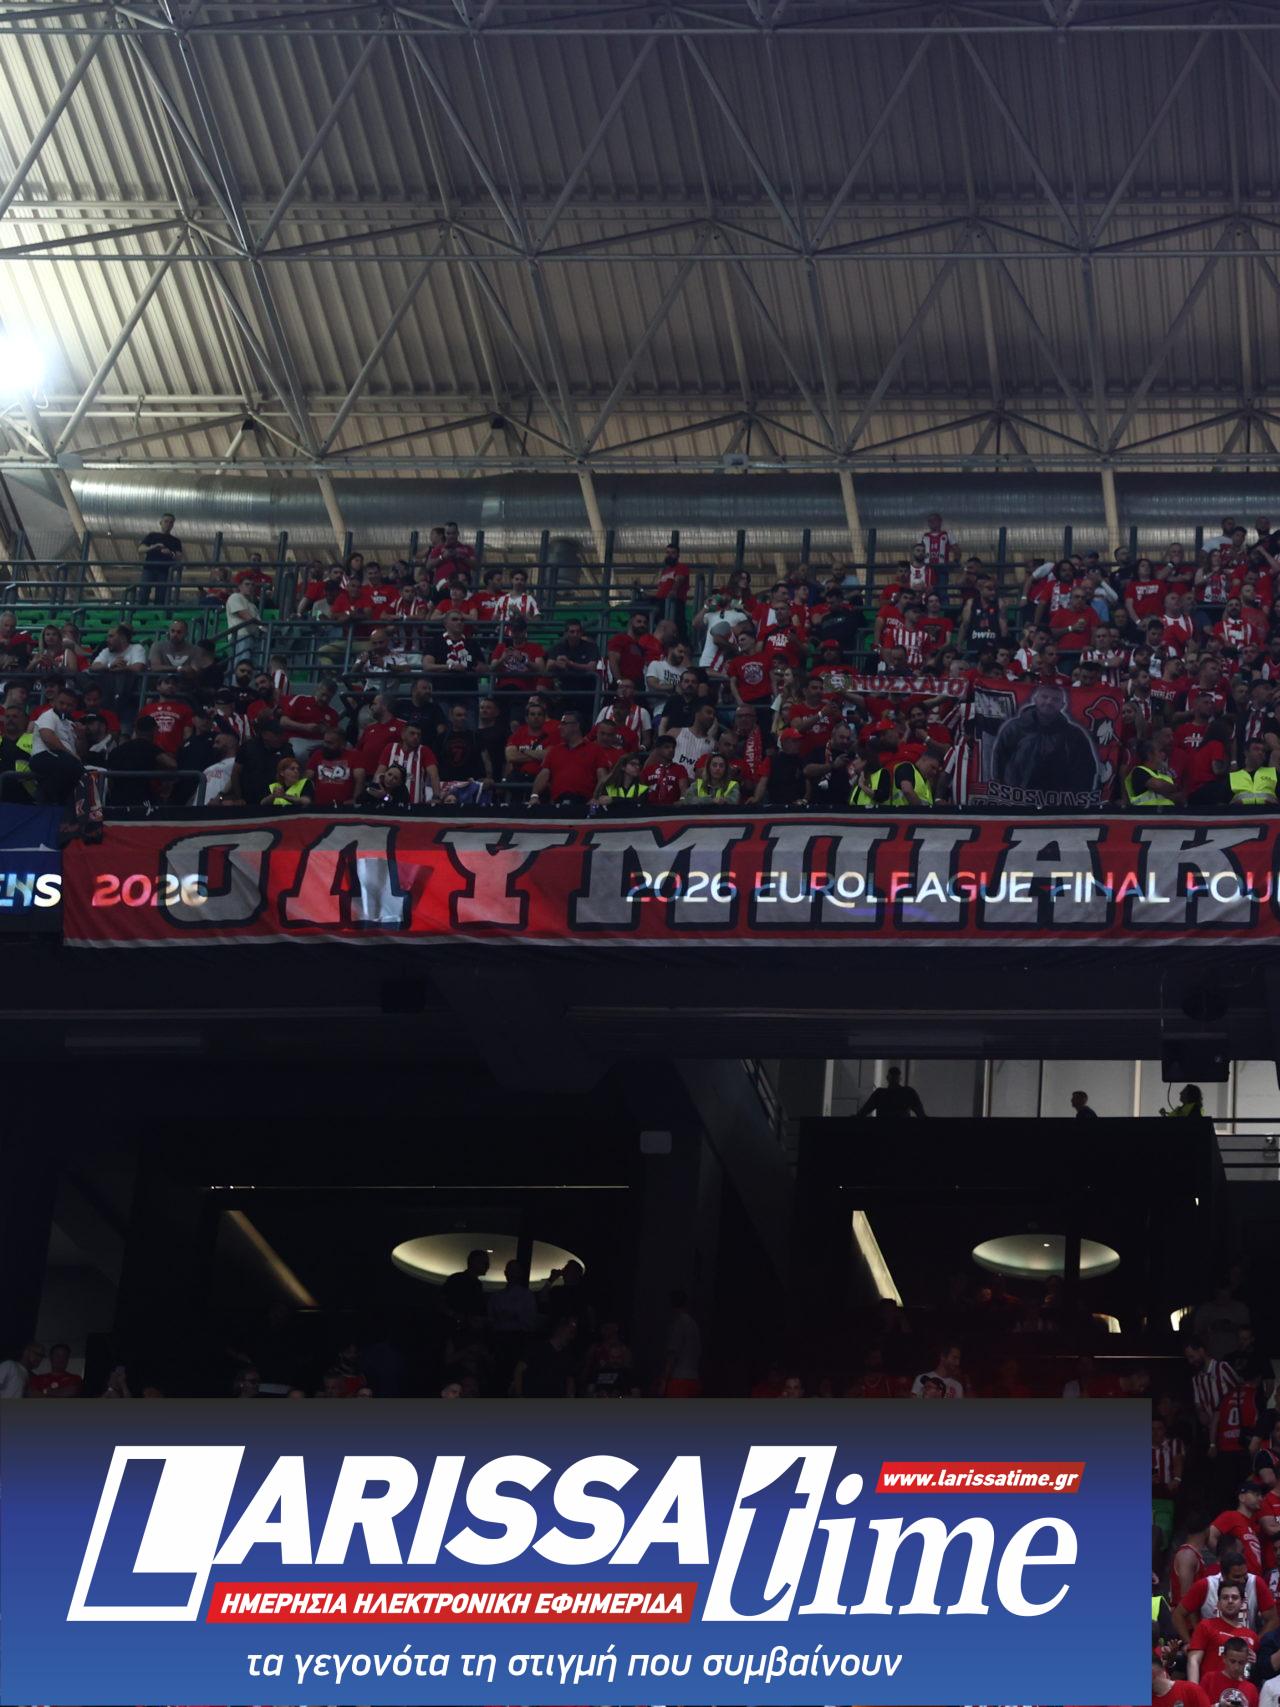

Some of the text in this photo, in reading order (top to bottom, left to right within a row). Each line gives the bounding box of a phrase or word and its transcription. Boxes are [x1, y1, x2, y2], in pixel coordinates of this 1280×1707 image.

[91, 873, 210, 907] 2026
[626, 871, 737, 903] 2026
[755, 871, 1034, 908] EUROLEAGUE
[1051, 871, 1170, 903] FINAL
